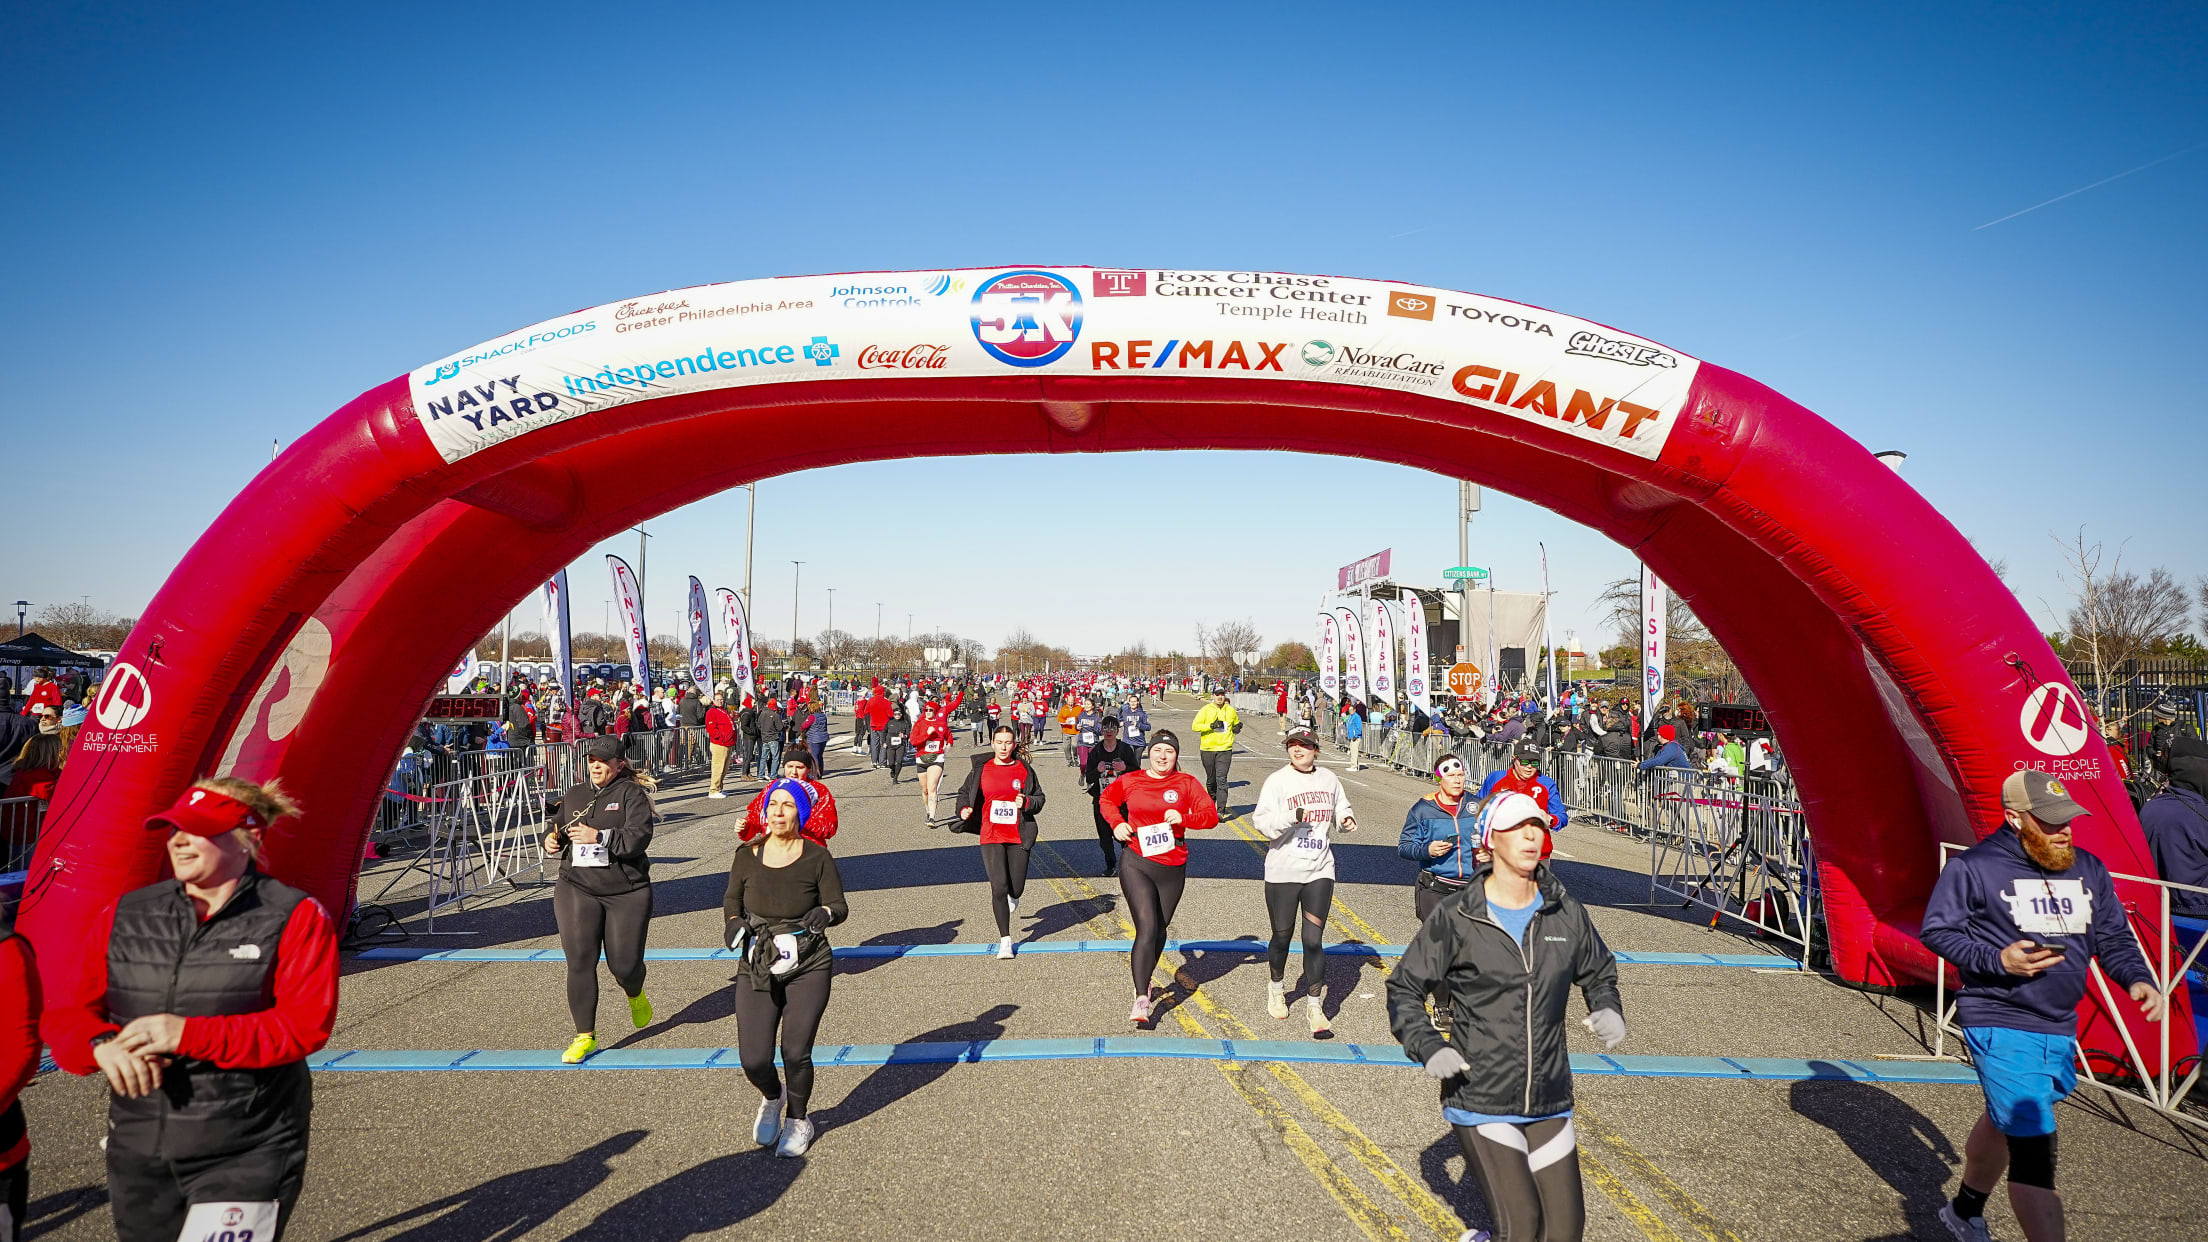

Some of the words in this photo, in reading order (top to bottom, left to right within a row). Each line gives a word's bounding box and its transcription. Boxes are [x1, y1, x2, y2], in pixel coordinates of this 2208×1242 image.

[830, 286, 907, 298] Johnson
[1155, 271, 1218, 283] Fox
[1227, 272, 1330, 288] Chase
[1155, 283, 1265, 298] Cancer
[1270, 285, 1372, 306] Center
[615, 314, 674, 334] Greater
[678, 302, 773, 324] Philadelphia
[777, 300, 813, 312] Area
[843, 296, 921, 308] Controls
[1216, 302, 1293, 320] Temple
[1300, 306, 1368, 325] Health
[1446, 304, 1554, 337] TOYOTA
[462, 340, 526, 367] SNACK
[529, 321, 596, 346] FOODS
[858, 343, 952, 370] Coca-Cola
[1091, 340, 1288, 371] RE/MAX
[563, 345, 795, 397] Independence
[1335, 346, 1445, 376] NovaCare
[1334, 367, 1436, 386] REHABILITATION
[427, 374, 521, 420] NAVY
[461, 392, 560, 431] YARD
[1451, 364, 1661, 439] GIANT
[617, 567, 643, 654] FINISH
[694, 584, 704, 659] FINISH
[1648, 573, 1658, 657] NISH
[726, 594, 744, 660] FINISH
[1377, 606, 1386, 672] FINISH
[1410, 598, 1420, 674] FINISH
[1325, 618, 1333, 673] FINISH
[1345, 613, 1357, 672] FINISH
[1450, 672, 1480, 686] STOP
[85, 731, 104, 743] OUR
[108, 732, 158, 744] PEOPLE
[2013, 760, 2046, 771] OUR
[2053, 758, 2100, 771] PEOPLE
[994, 808, 1014, 817] 4253
[1287, 791, 1331, 811] UNIVERSITY
[1145, 832, 1169, 847] 2476
[1297, 837, 1323, 850] 2568
[2030, 897, 2073, 915] 1169
